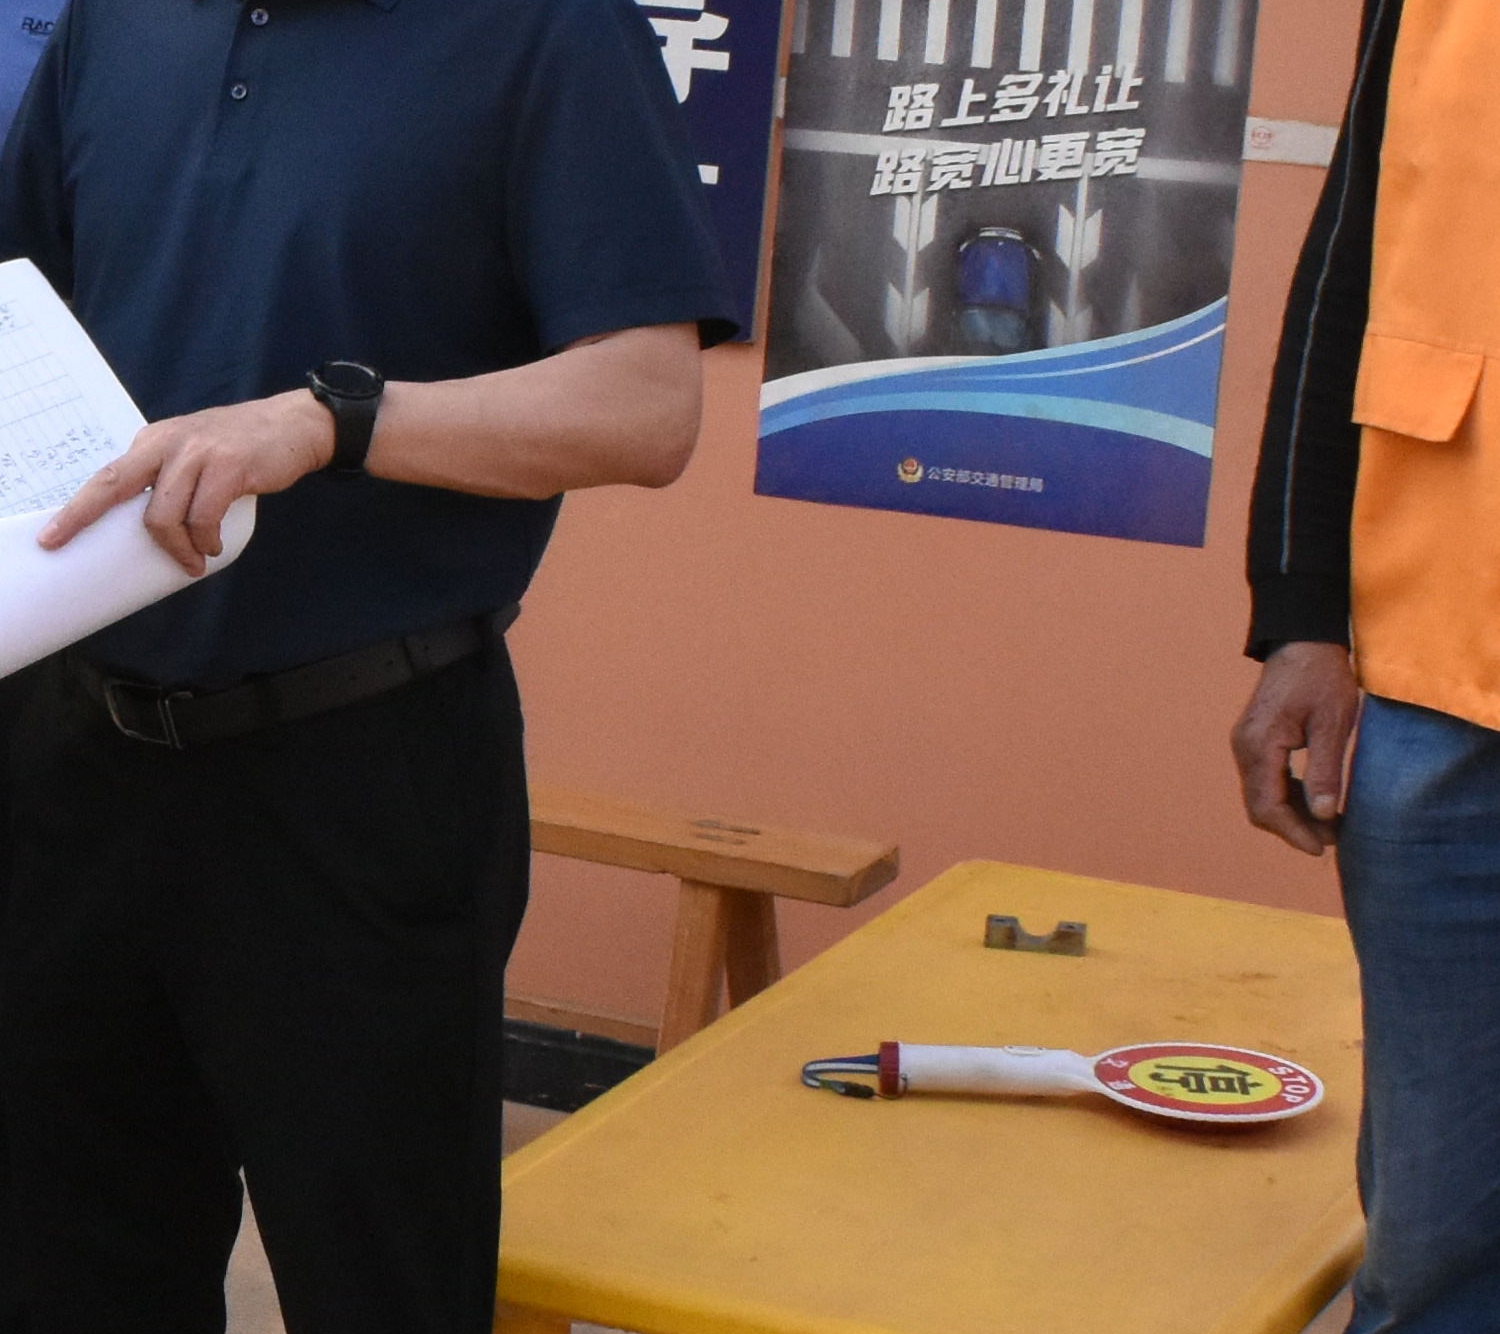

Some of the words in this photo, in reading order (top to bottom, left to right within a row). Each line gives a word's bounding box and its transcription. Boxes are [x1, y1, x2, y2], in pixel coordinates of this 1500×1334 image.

[882, 64, 1145, 134] 路上多礼让
[868, 127, 1147, 198] 路宽心更宽
[926, 466, 1045, 493] 公安部交通管理局
[1150, 1064, 1262, 1096] 停
[1268, 1064, 1311, 1104] STOP
